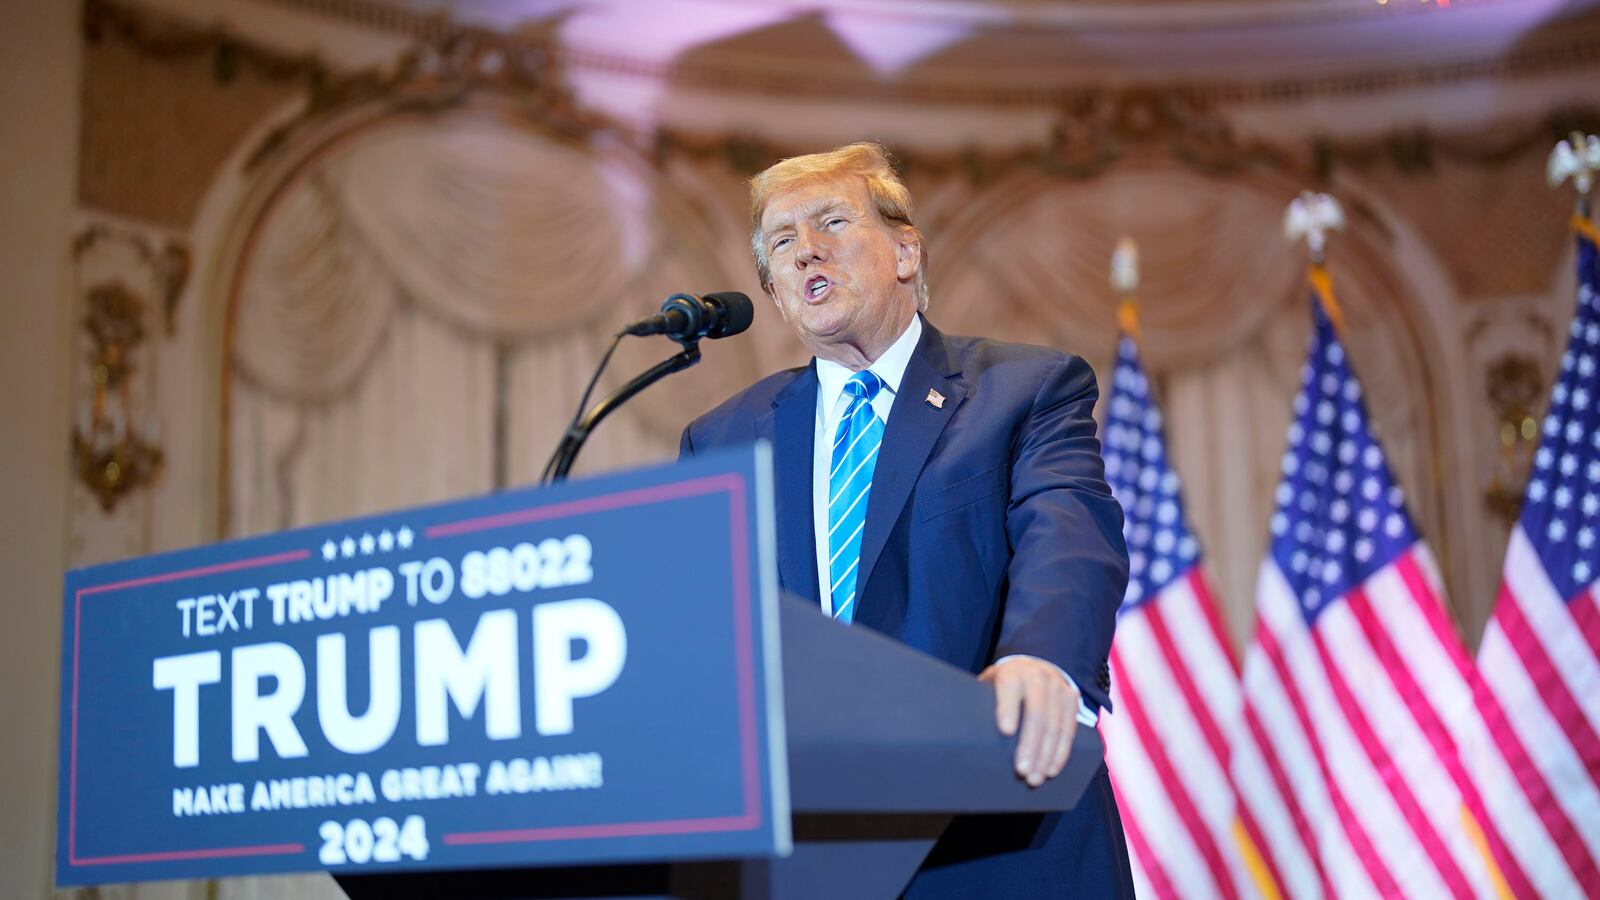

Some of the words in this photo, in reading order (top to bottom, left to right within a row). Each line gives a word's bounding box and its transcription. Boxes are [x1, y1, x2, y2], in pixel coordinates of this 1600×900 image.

[177, 588, 259, 638] TEXT
[266, 568, 394, 625] TRUMP
[399, 558, 454, 606] TO
[461, 534, 593, 598] 88022
[153, 598, 627, 767] TRUMP
[173, 783, 244, 816] MAKE
[251, 773, 376, 810] AMERICA
[381, 763, 480, 802] GREAT
[485, 752, 603, 794] AGAIN!
[319, 815, 428, 864] 2024
